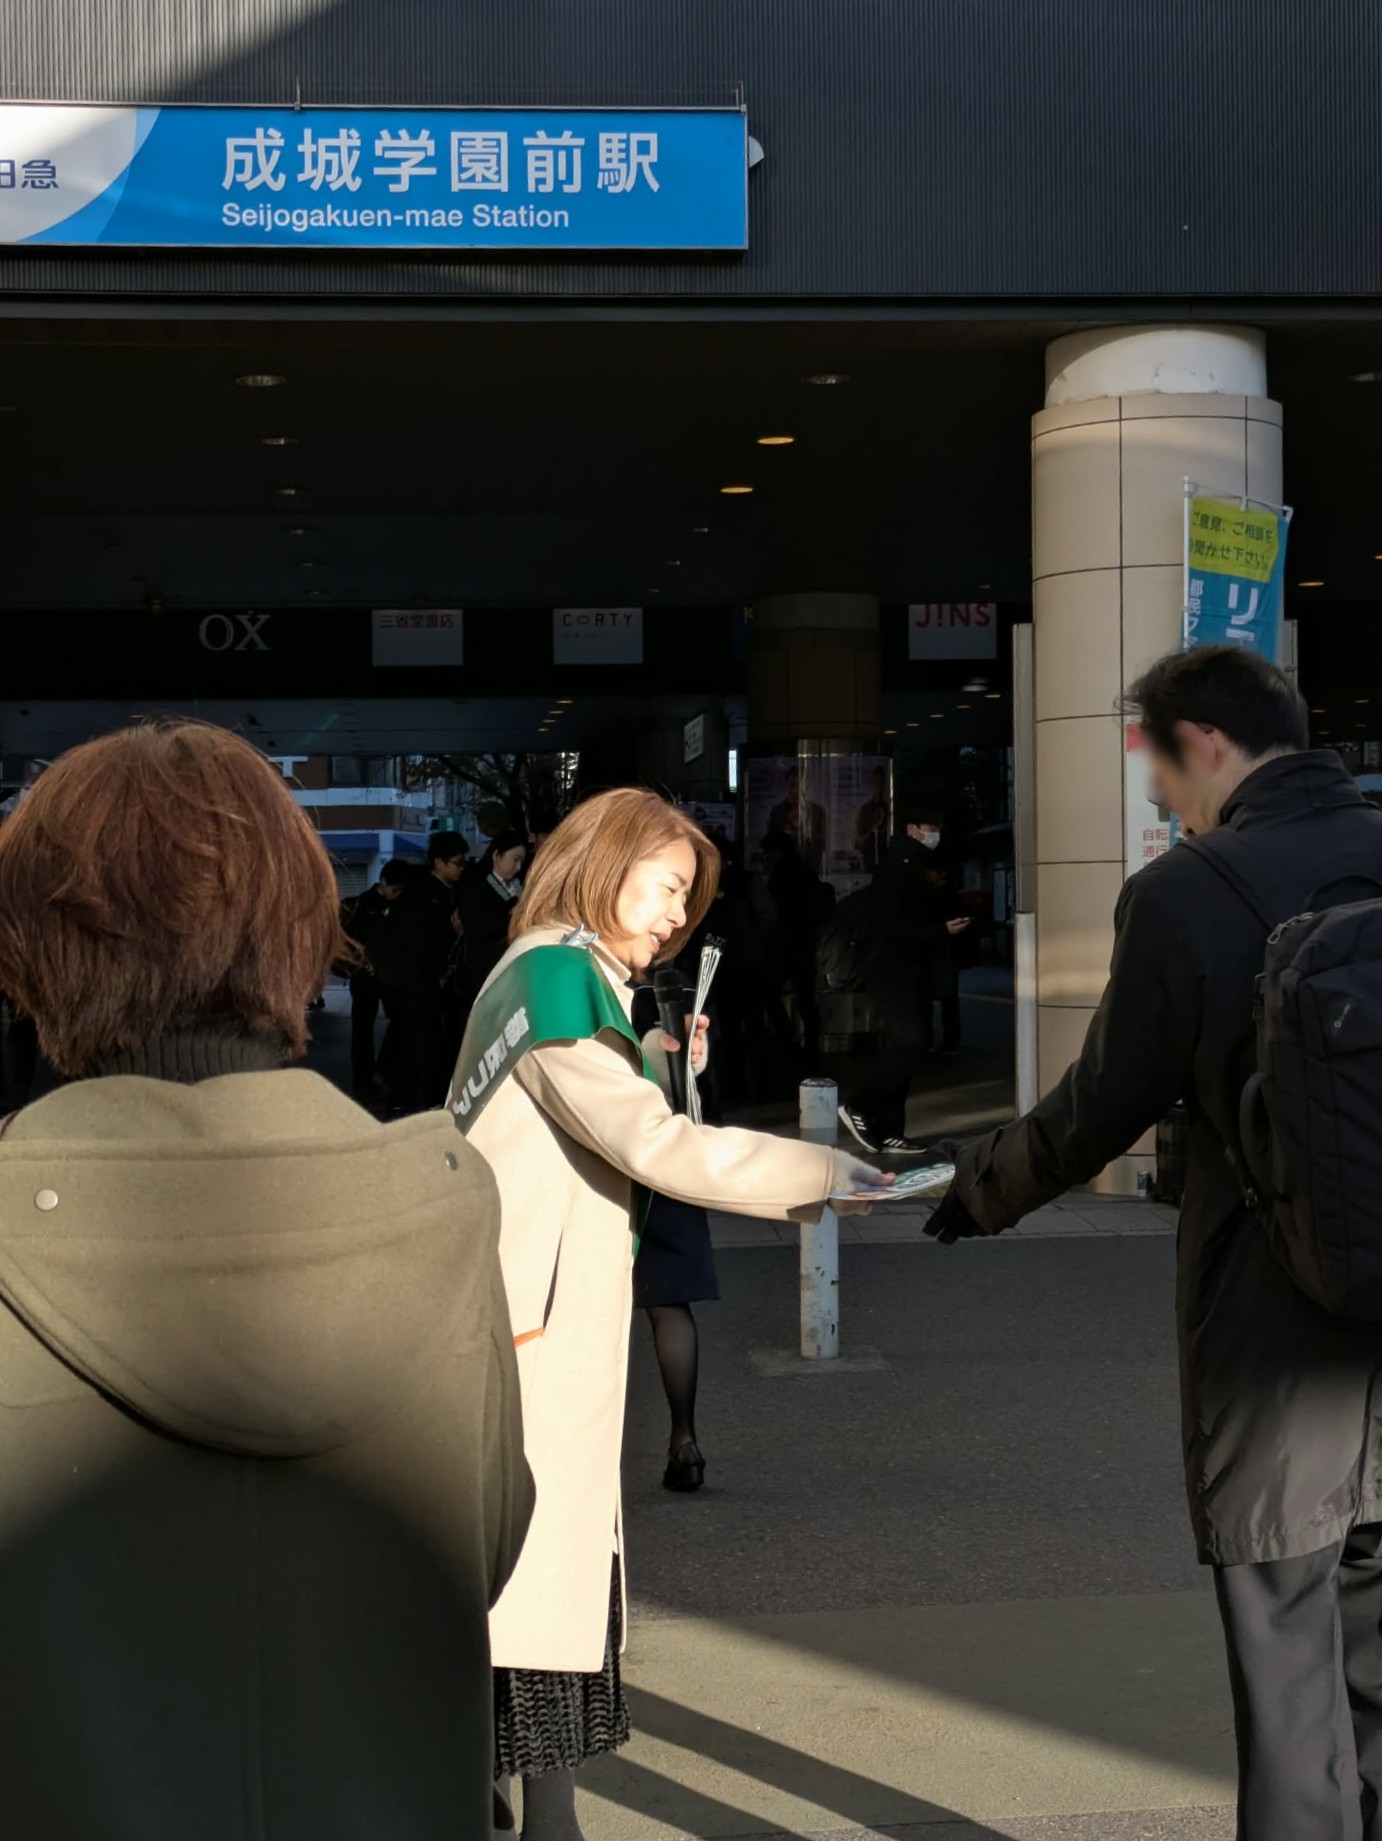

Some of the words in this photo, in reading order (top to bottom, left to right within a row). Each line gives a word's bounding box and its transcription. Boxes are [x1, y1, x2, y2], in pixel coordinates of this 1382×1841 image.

[222, 127, 661, 193] 成城学園前駅
[222, 203, 463, 232] Seijogakuen-mae
[472, 203, 569, 228] Station
[198, 613, 272, 651] OX
[380, 614, 454, 628] 三省堂書店
[563, 613, 632, 627] CORTY
